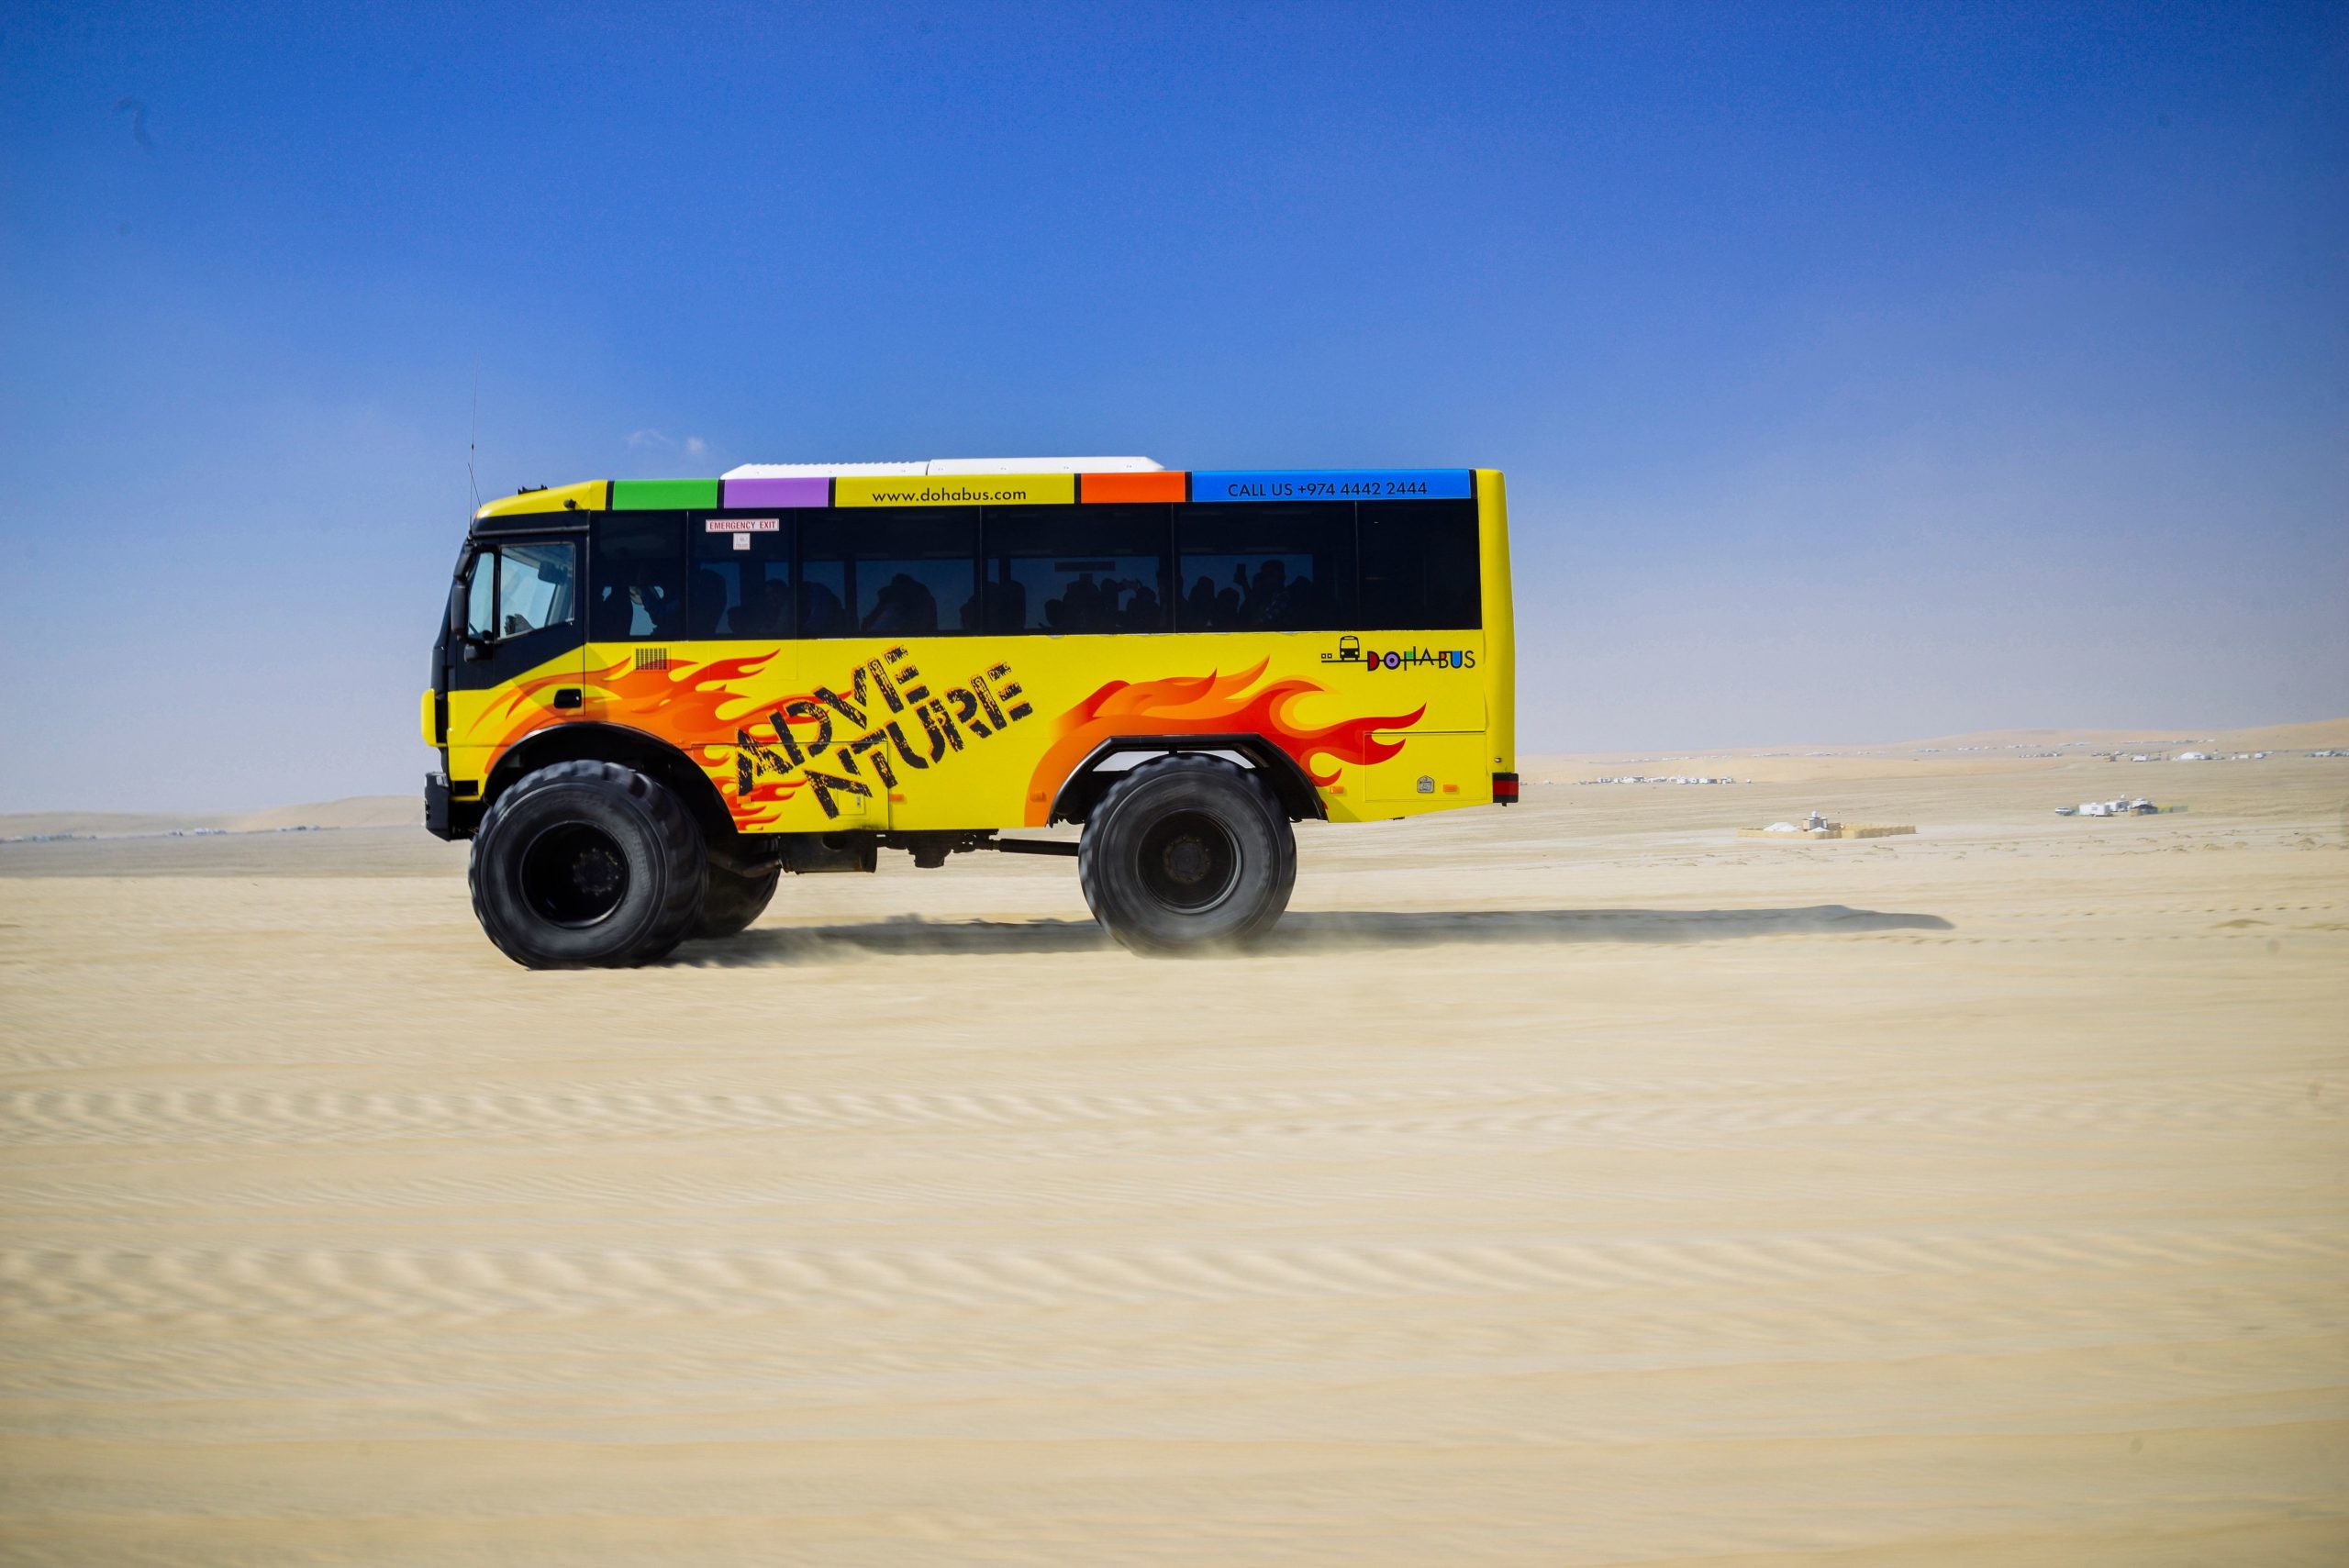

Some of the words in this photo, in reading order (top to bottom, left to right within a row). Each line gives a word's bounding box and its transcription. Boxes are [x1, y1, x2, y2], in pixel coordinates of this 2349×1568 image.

[872, 487, 1027, 502] www.dohabus.com
[1228, 484, 1266, 496] CALL
[1272, 484, 1293, 496] US
[1297, 483, 1336, 496] +974
[1340, 482, 1381, 495] 4442
[1386, 482, 1428, 495] 2444
[709, 520, 756, 530] EMERGENCY
[759, 520, 776, 529] EXIT
[1366, 646, 1476, 672] DOHABUS
[735, 644, 930, 796] ADVE
[802, 660, 1033, 819] NTURE
